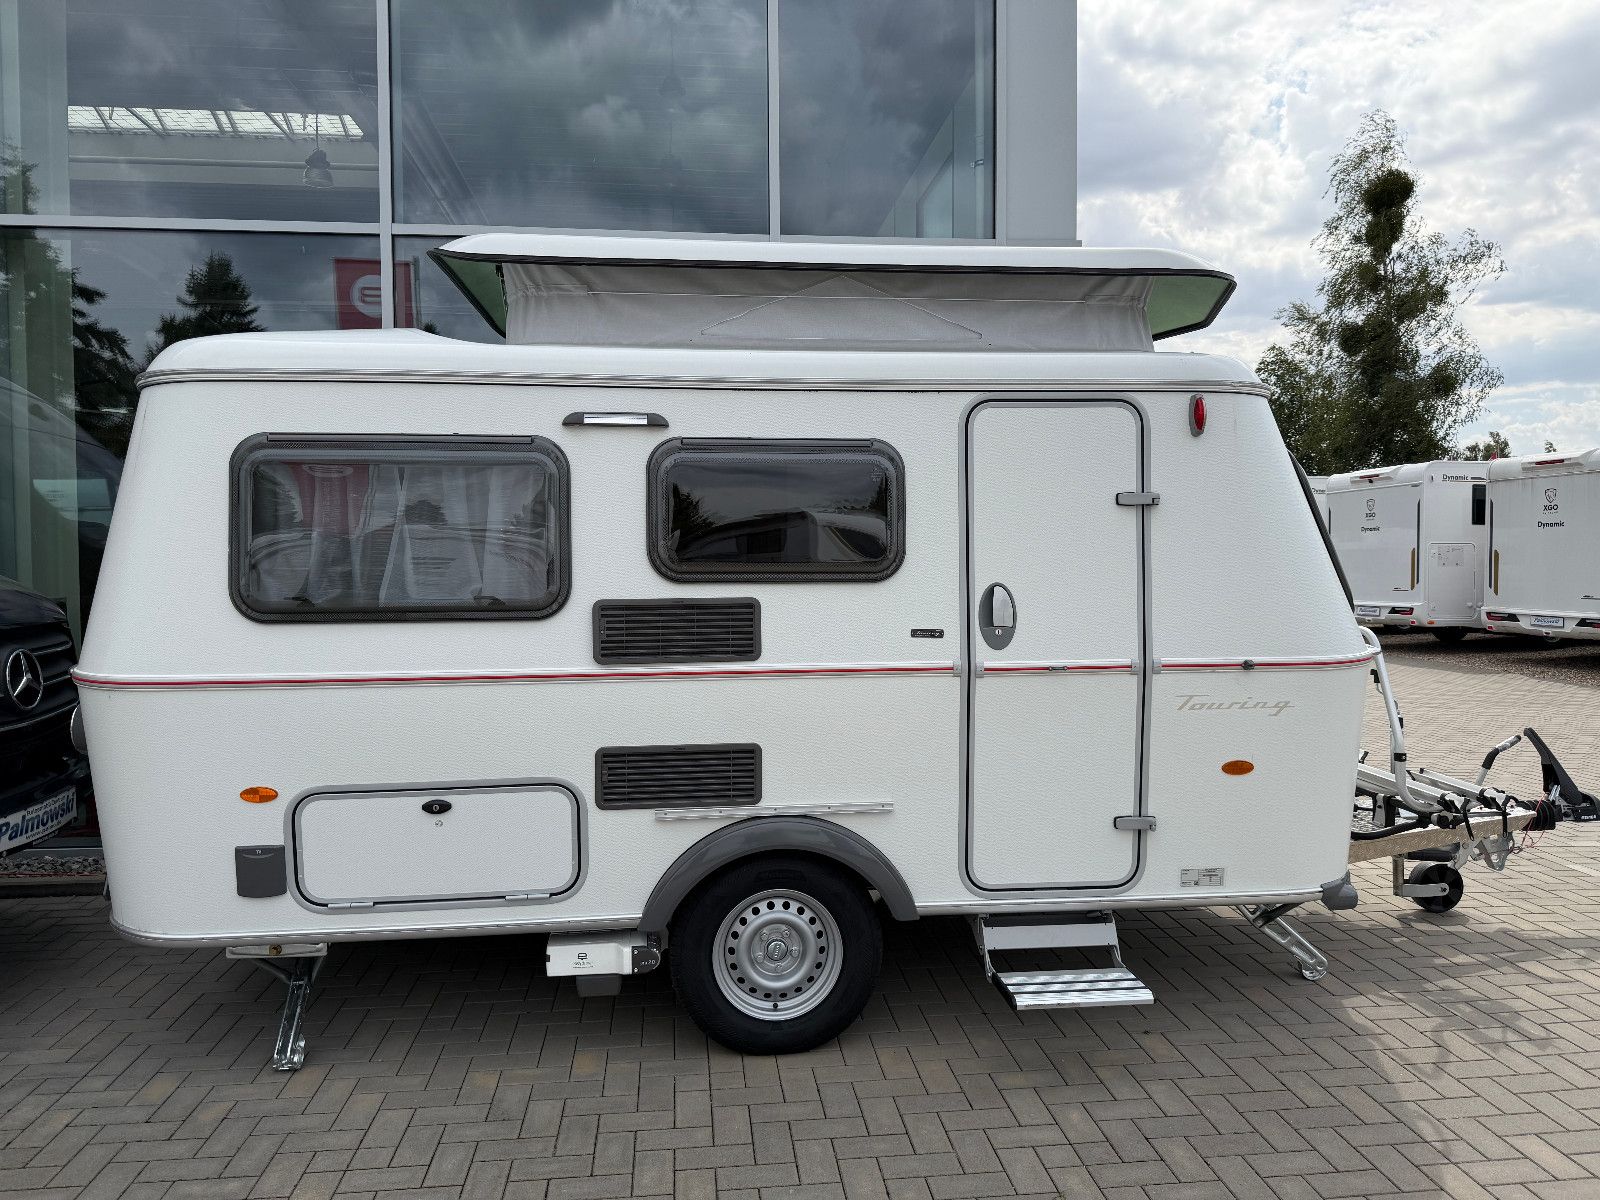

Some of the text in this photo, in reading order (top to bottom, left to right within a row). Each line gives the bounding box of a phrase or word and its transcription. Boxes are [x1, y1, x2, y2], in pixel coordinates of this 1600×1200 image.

[1537, 521, 1565, 529] Dynamic
[1174, 694, 1295, 717] Touring
[0, 791, 75, 841] Palmowski
